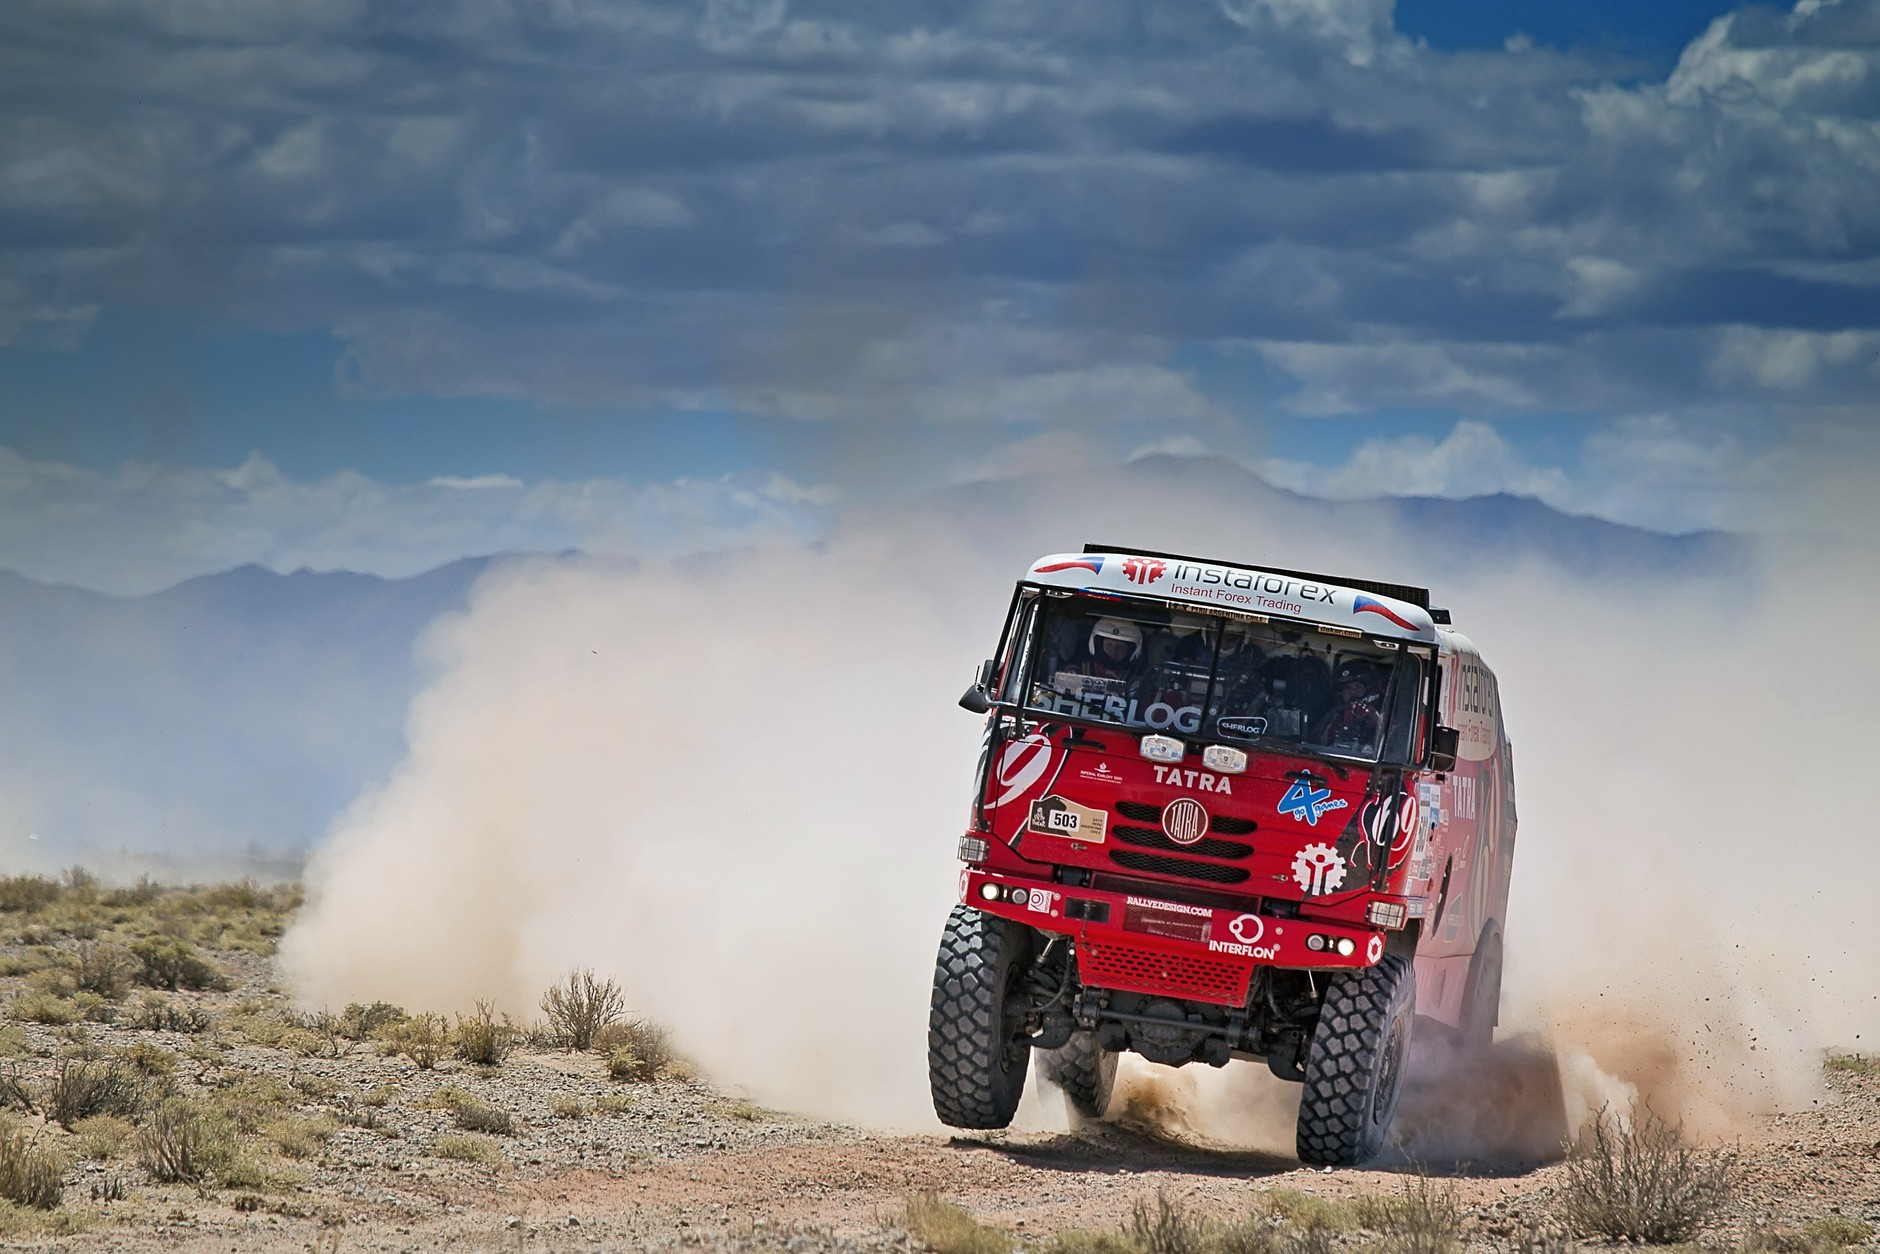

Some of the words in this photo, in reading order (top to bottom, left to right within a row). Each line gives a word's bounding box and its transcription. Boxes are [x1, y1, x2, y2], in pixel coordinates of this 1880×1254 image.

[1174, 563, 1338, 604] instaforex
[1171, 583, 1213, 599] Instant
[1216, 587, 1251, 604] Forex
[1256, 596, 1302, 615] Trading
[1209, 608, 1245, 621] ARGENTINA
[1320, 626, 1360, 638] dakar.com
[1221, 721, 1261, 734] SHERLOG
[1153, 765, 1232, 794] TATRA
[1453, 775, 1476, 820] TATRA
[1294, 808, 1306, 820] go
[1314, 799, 1347, 817] games
[1054, 813, 1077, 829] 503
[1171, 802, 1199, 840] TATRA
[1127, 896, 1213, 918] RALLYEDESIGN.COM
[1209, 940, 1275, 960] INTERFLON
